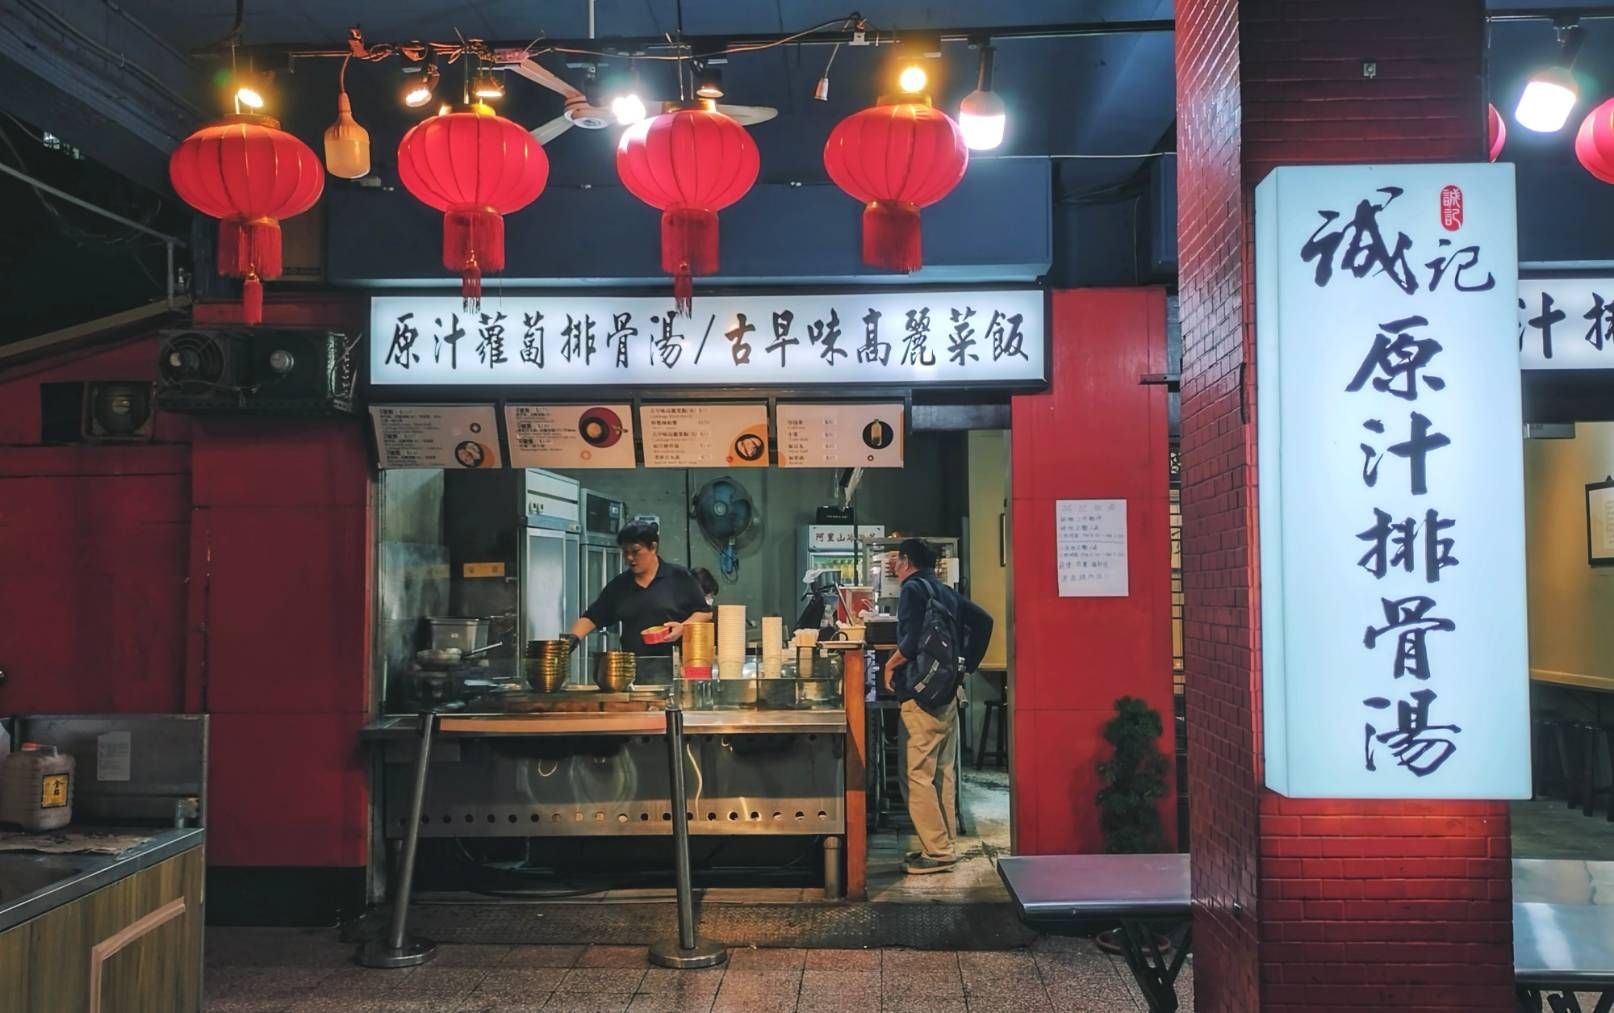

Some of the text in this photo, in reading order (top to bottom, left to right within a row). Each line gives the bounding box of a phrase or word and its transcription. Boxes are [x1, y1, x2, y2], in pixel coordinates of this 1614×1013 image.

[1345, 315, 1462, 778] 原汁排骨湯
